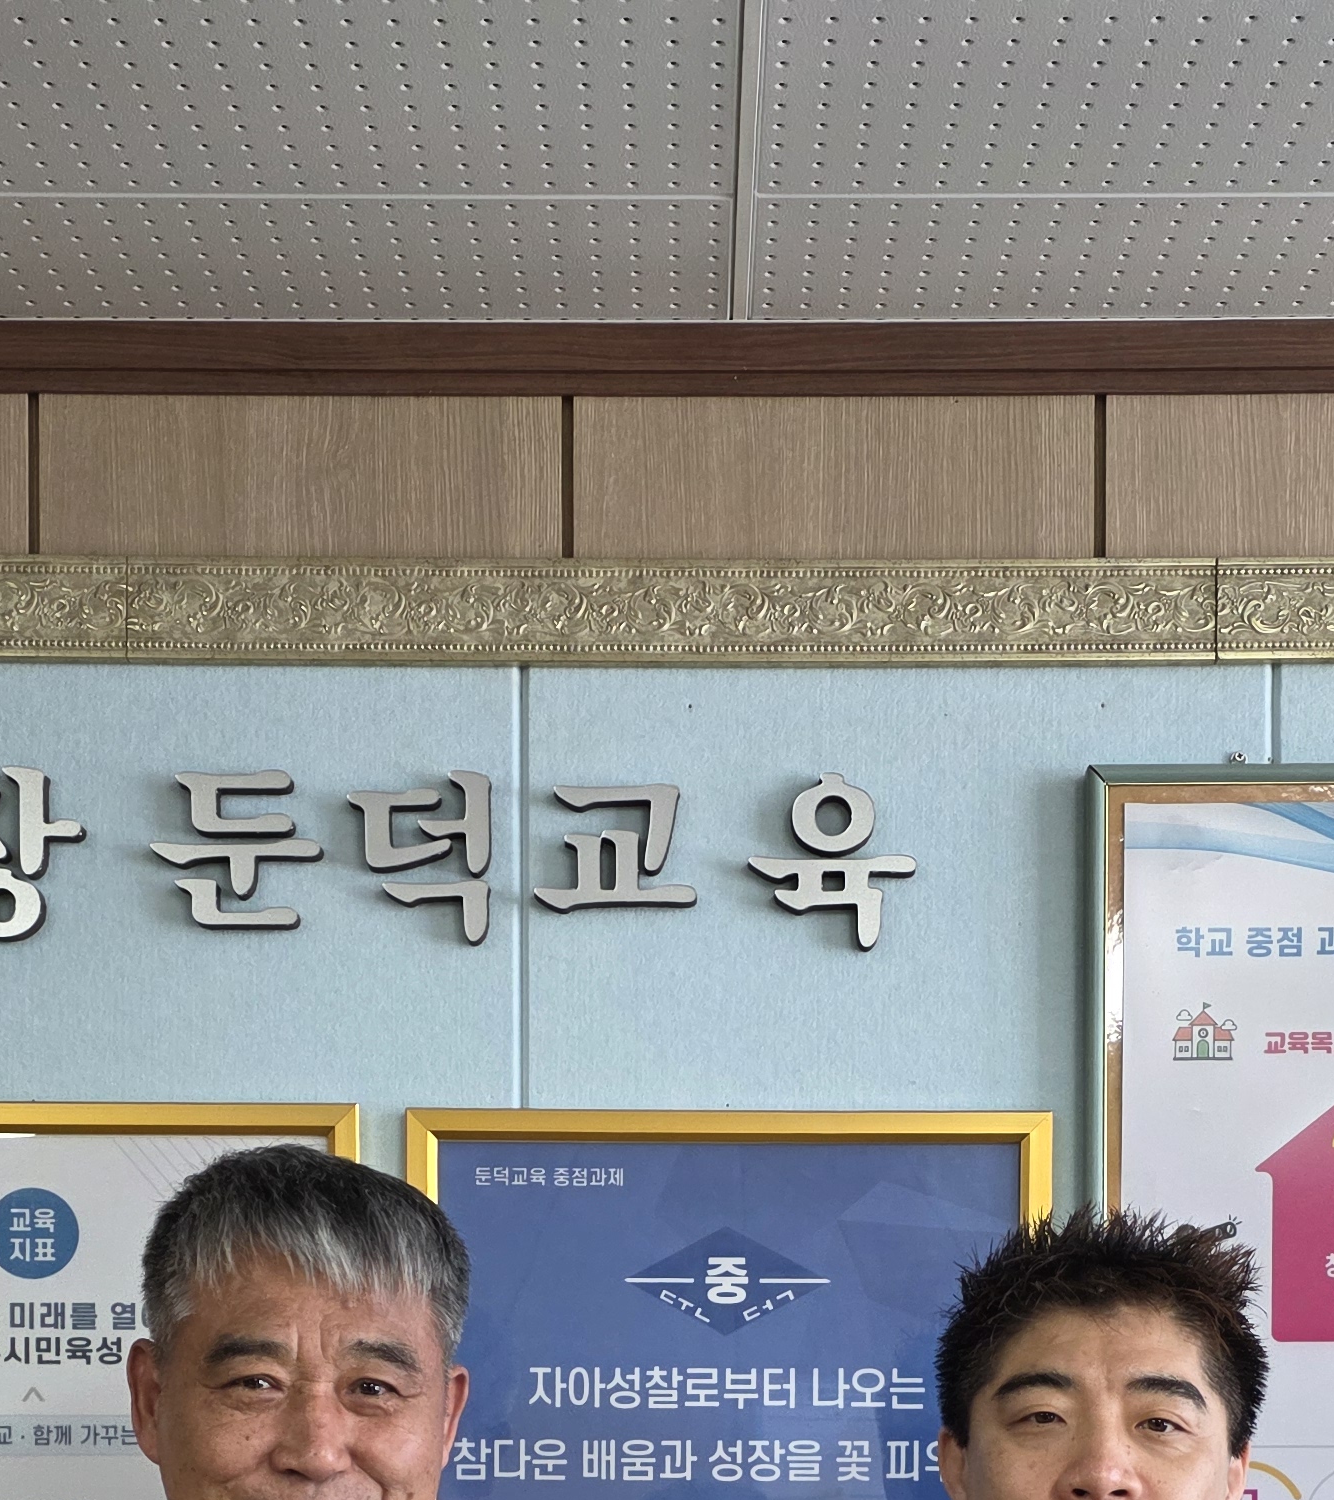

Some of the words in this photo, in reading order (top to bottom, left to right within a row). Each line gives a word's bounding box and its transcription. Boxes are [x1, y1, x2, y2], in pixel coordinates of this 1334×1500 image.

[1176, 927, 1233, 958] 학교
[1246, 927, 1302, 957] 중점
[475, 1167, 546, 1186] 둔덕교육
[554, 1168, 623, 1186] 중점과제
[10, 1208, 55, 1232] 교육
[10, 1238, 55, 1261] 지표
[705, 1257, 748, 1304] 중
[10, 1302, 97, 1330] 미래를
[529, 1366, 795, 1409] 자아성찰로부터
[813, 1368, 925, 1409] 나오는
[33, 1425, 71, 1446] 함께
[450, 1434, 567, 1480] 참다운
[583, 1440, 697, 1481] 배움과
[709, 1440, 822, 1481] 성장을
[836, 1441, 871, 1481] 꽃
